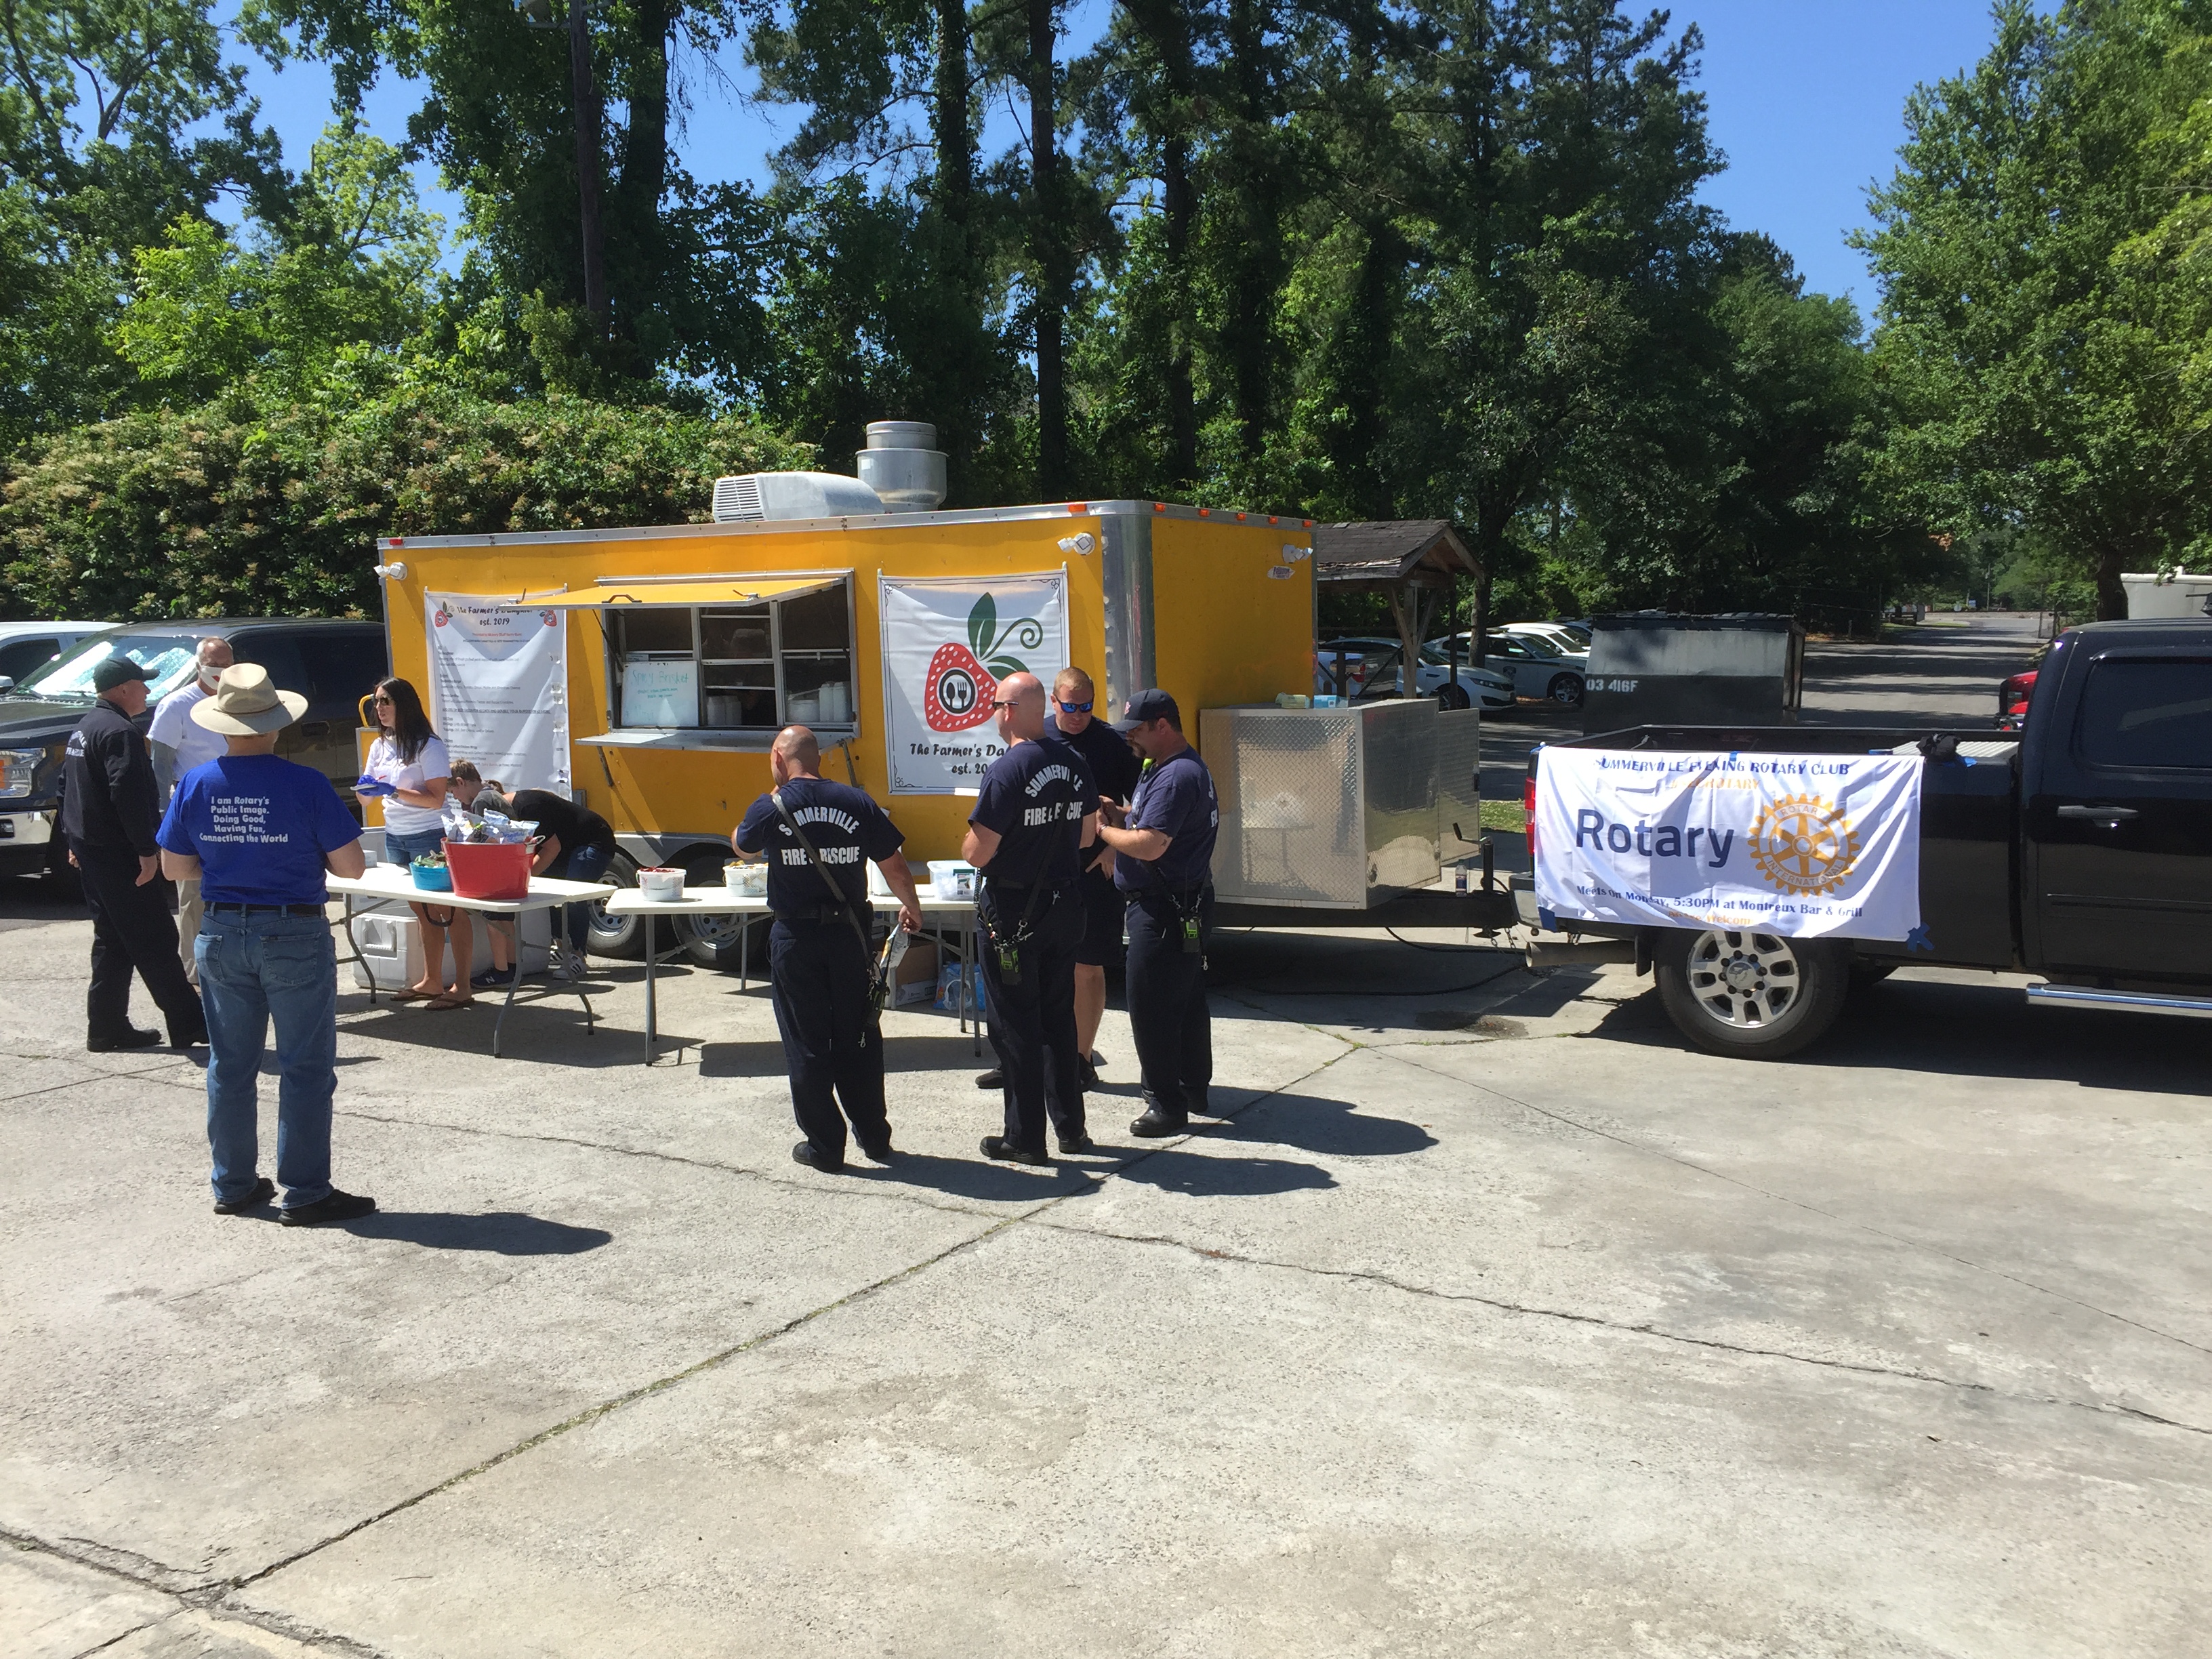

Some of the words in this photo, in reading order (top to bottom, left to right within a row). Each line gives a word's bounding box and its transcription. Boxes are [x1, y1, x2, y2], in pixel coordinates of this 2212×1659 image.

[468, 606, 499, 615] Farmer's
[479, 618, 492, 626] est.
[493, 617, 510, 626] 2019
[1586, 678, 1604, 691] 03
[910, 743, 929, 755] The
[933, 743, 982, 758] Farmer's
[951, 762, 971, 775] est.
[975, 762, 988, 774] 20
[1750, 761, 1807, 775] ROTARY
[1811, 762, 1850, 775] CLUB
[211, 796, 215, 804] I
[234, 796, 270, 806] Rotary's
[211, 806, 237, 815] Public
[240, 806, 270, 815] Image.
[1024, 806, 1047, 826] FIRE
[213, 815, 239, 825] Doing
[242, 815, 266, 825] Good,
[779, 806, 861, 836] SMMERVILLE
[214, 825, 247, 834] Having
[249, 825, 266, 834] Fun,
[199, 833, 245, 844] Connecting
[247, 834, 259, 843] the
[260, 834, 289, 844] World
[1576, 808, 1734, 868] Rotary
[781, 848, 808, 865] FIRE
[819, 846, 860, 865] RESCUE
[1766, 860, 1843, 886] INTERNATIONAL
[1576, 886, 1607, 896] Meets
[1609, 889, 1622, 899] On
[1673, 897, 1719, 909] 5:30PM
[1723, 900, 1736, 909] at
[1739, 900, 1797, 913] Montreux
[1800, 903, 1822, 915] Bar
[1825, 906, 1833, 916] &
[1838, 907, 1863, 917] Grill
[1706, 914, 1755, 926] Welcom
